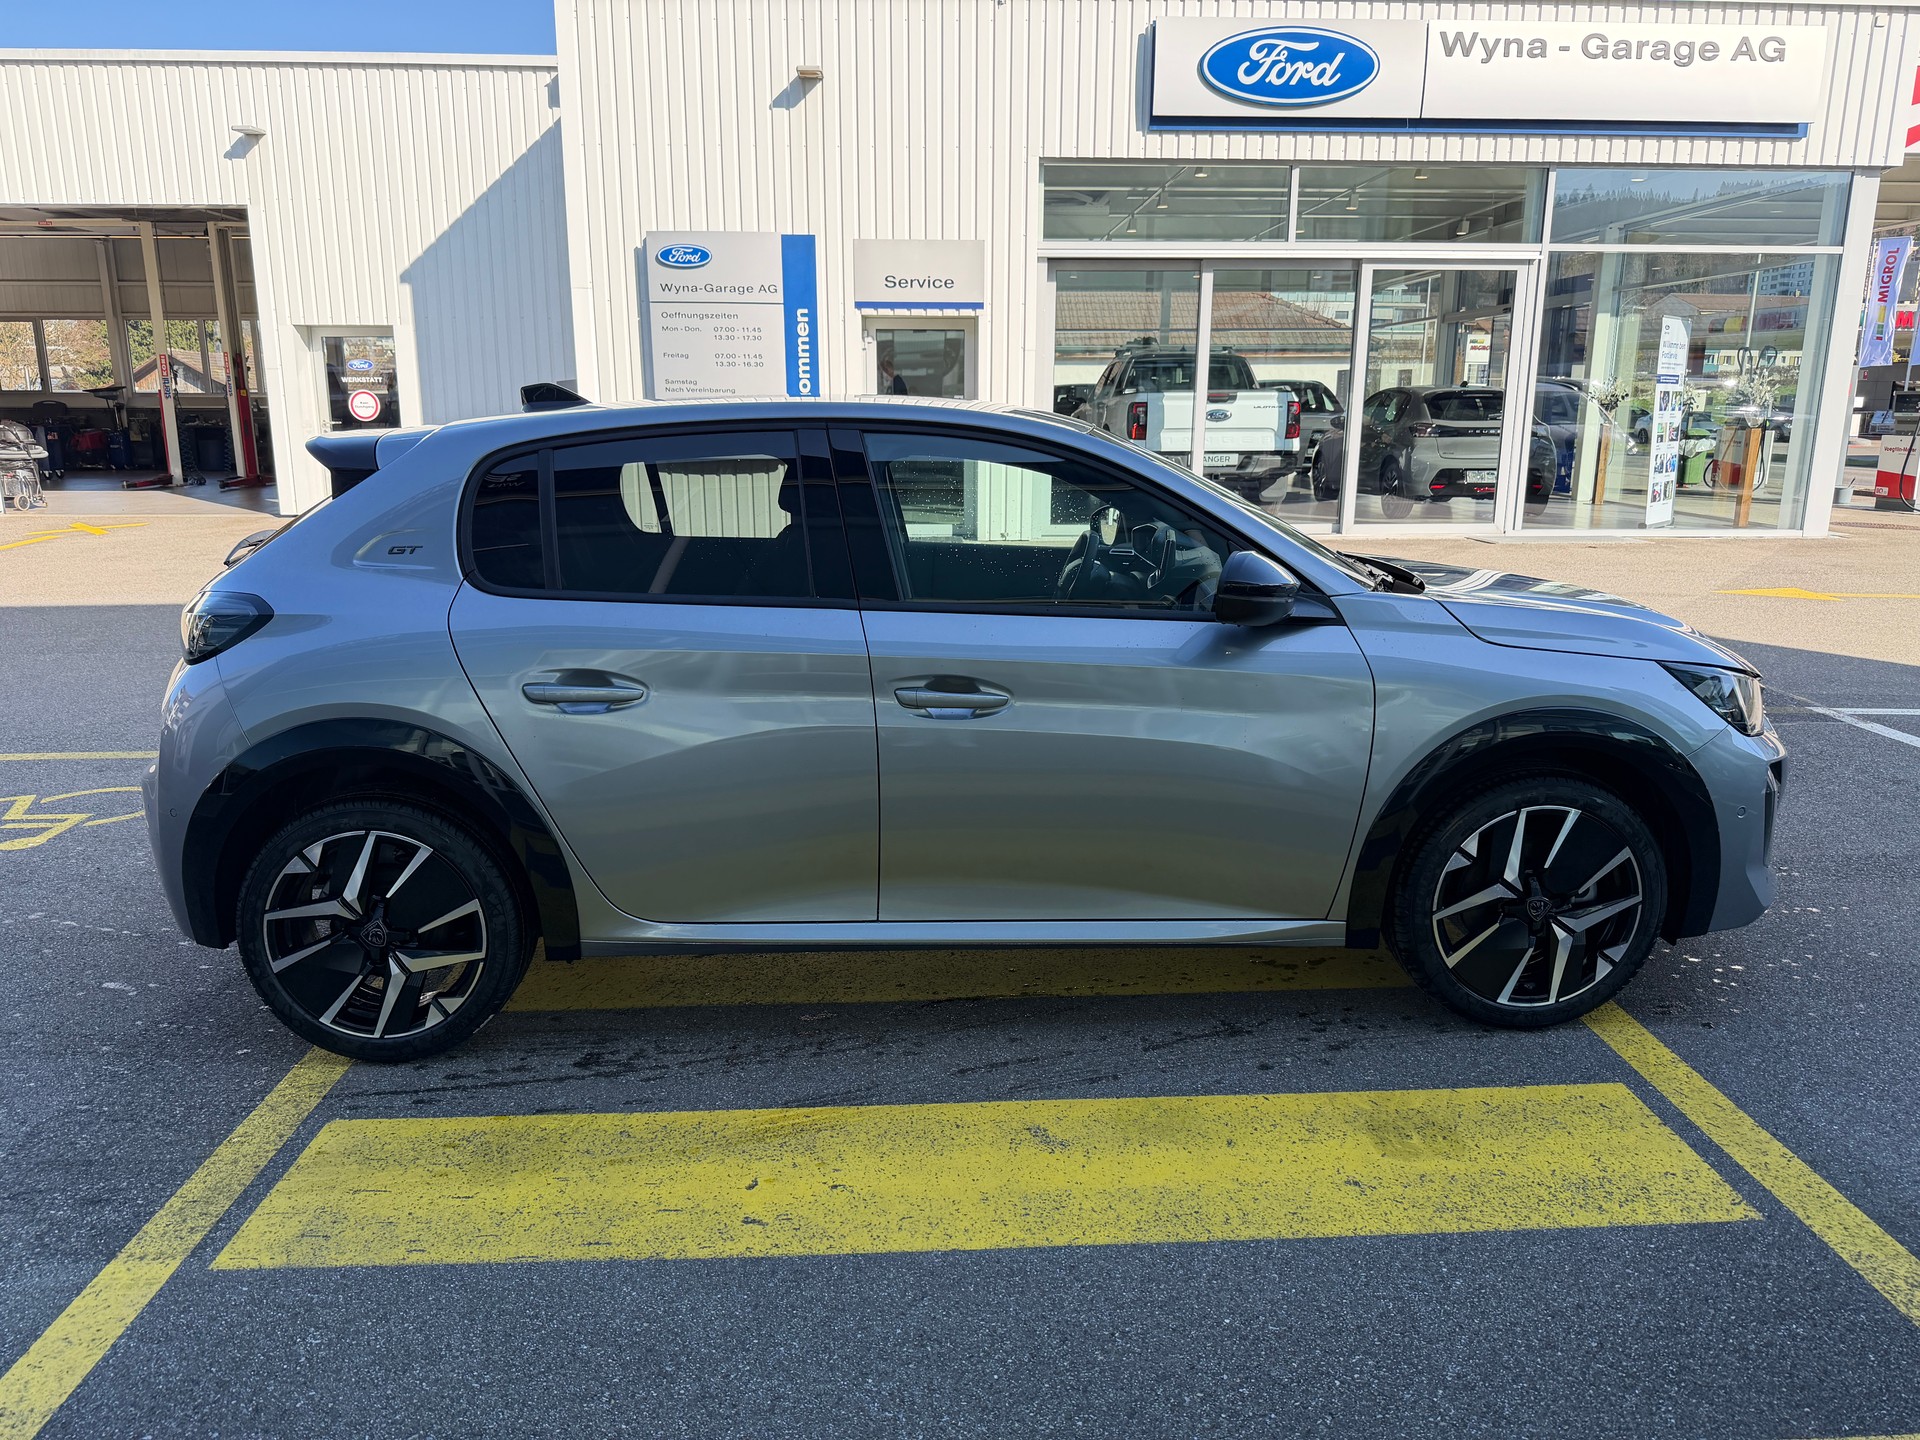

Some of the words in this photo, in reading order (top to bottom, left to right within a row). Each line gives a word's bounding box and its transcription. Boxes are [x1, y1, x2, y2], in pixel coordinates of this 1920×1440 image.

[1439, 31, 1548, 64] Wyna
[1581, 33, 1720, 67] Garage
[1730, 36, 1786, 62] AG
[1237, 38, 1345, 87] Ford
[668, 247, 701, 262] Ford
[1877, 247, 1900, 303] MIGROL
[884, 275, 955, 289] Service
[659, 283, 754, 295] Wyna-Garage
[758, 284, 778, 293] AG
[661, 312, 739, 320] Oeffnungszeiten
[663, 352, 689, 360] Freitag
[686, 387, 736, 395] Vereinbarung
[388, 545, 423, 555] GT
